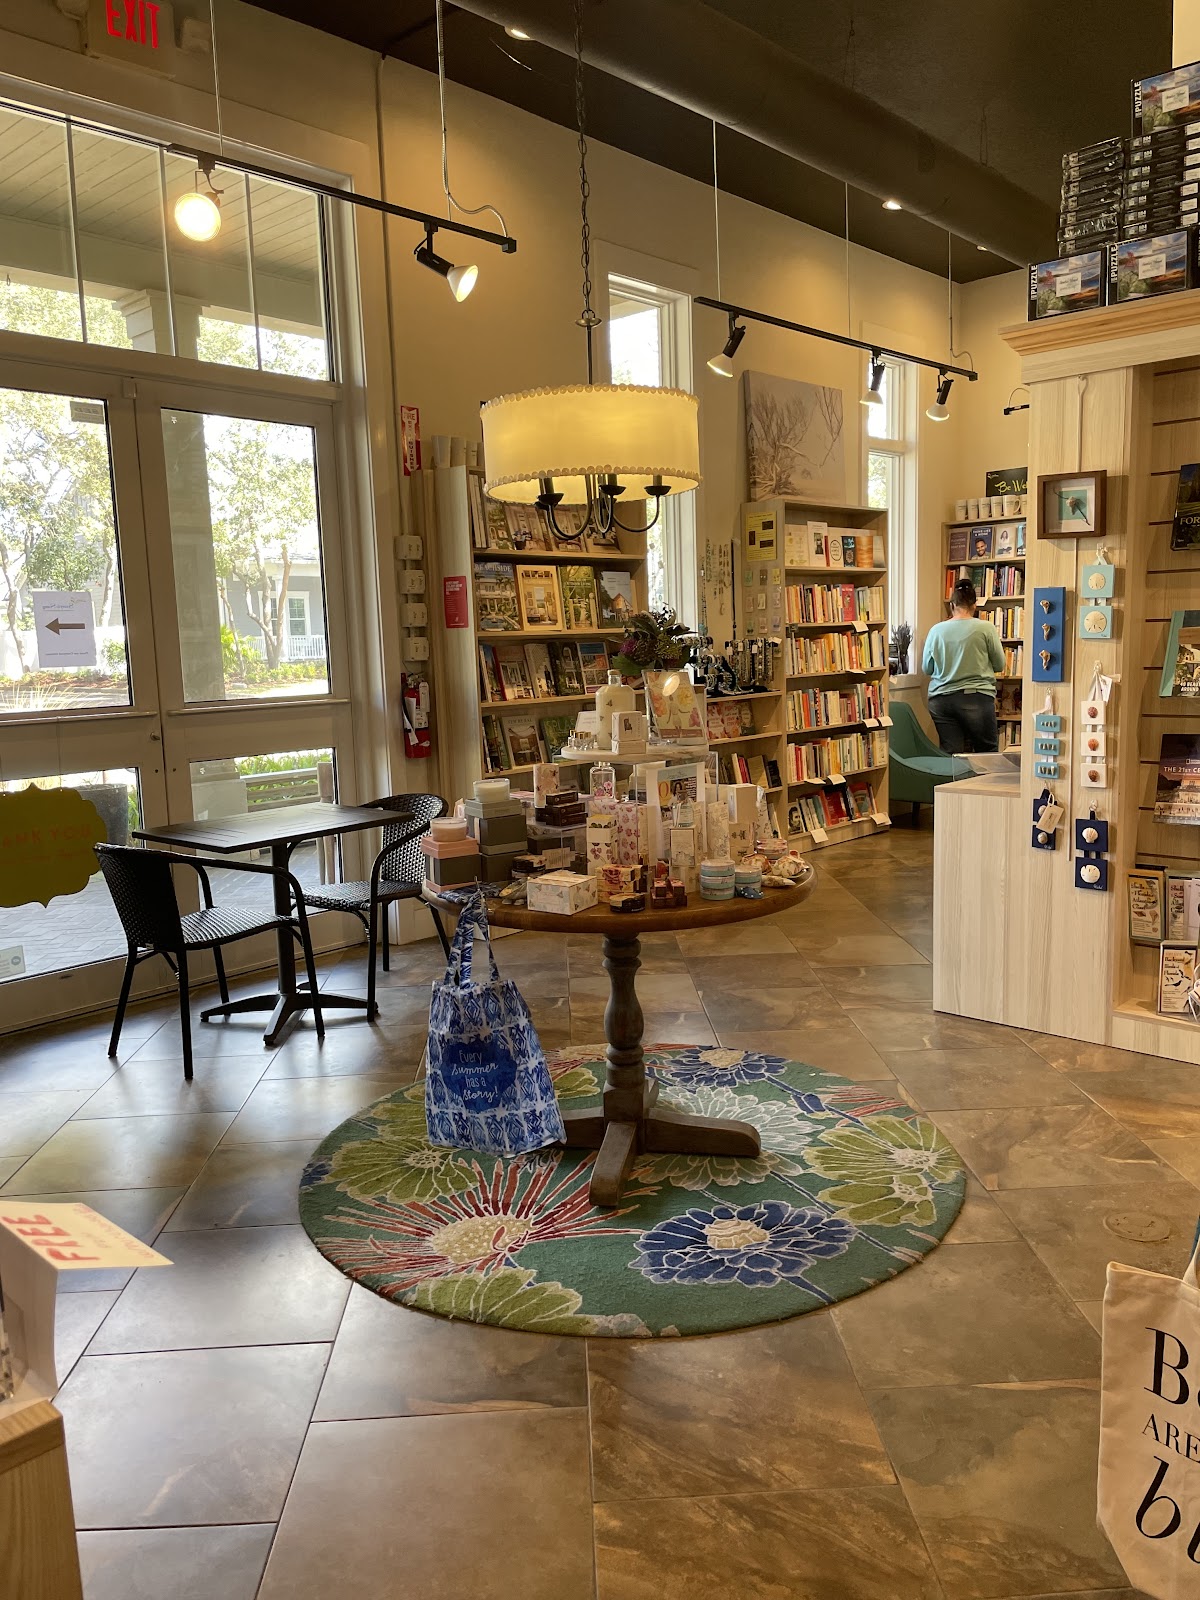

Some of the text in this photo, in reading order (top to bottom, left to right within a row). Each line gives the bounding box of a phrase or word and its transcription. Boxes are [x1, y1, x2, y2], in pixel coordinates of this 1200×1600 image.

[106, 0, 160, 48] EXIT
[1134, 81, 1142, 113] PUZZLE
[1110, 246, 1118, 278] PUZZLE
[1030, 265, 1038, 295] PUZZLE
[407, 421, 416, 470] EXGUISHER
[546, 718, 575, 731] SPLAS
[48, 824, 92, 841] YOU
[452, 1062, 498, 1076] summer
[459, 1049, 482, 1065] Every
[463, 1086, 498, 1103] story!
[465, 1075, 486, 1088] has a
[1, 1214, 99, 1261] FREE
[1143, 1326, 1200, 1408] B
[1142, 1413, 1200, 1464] ARE
